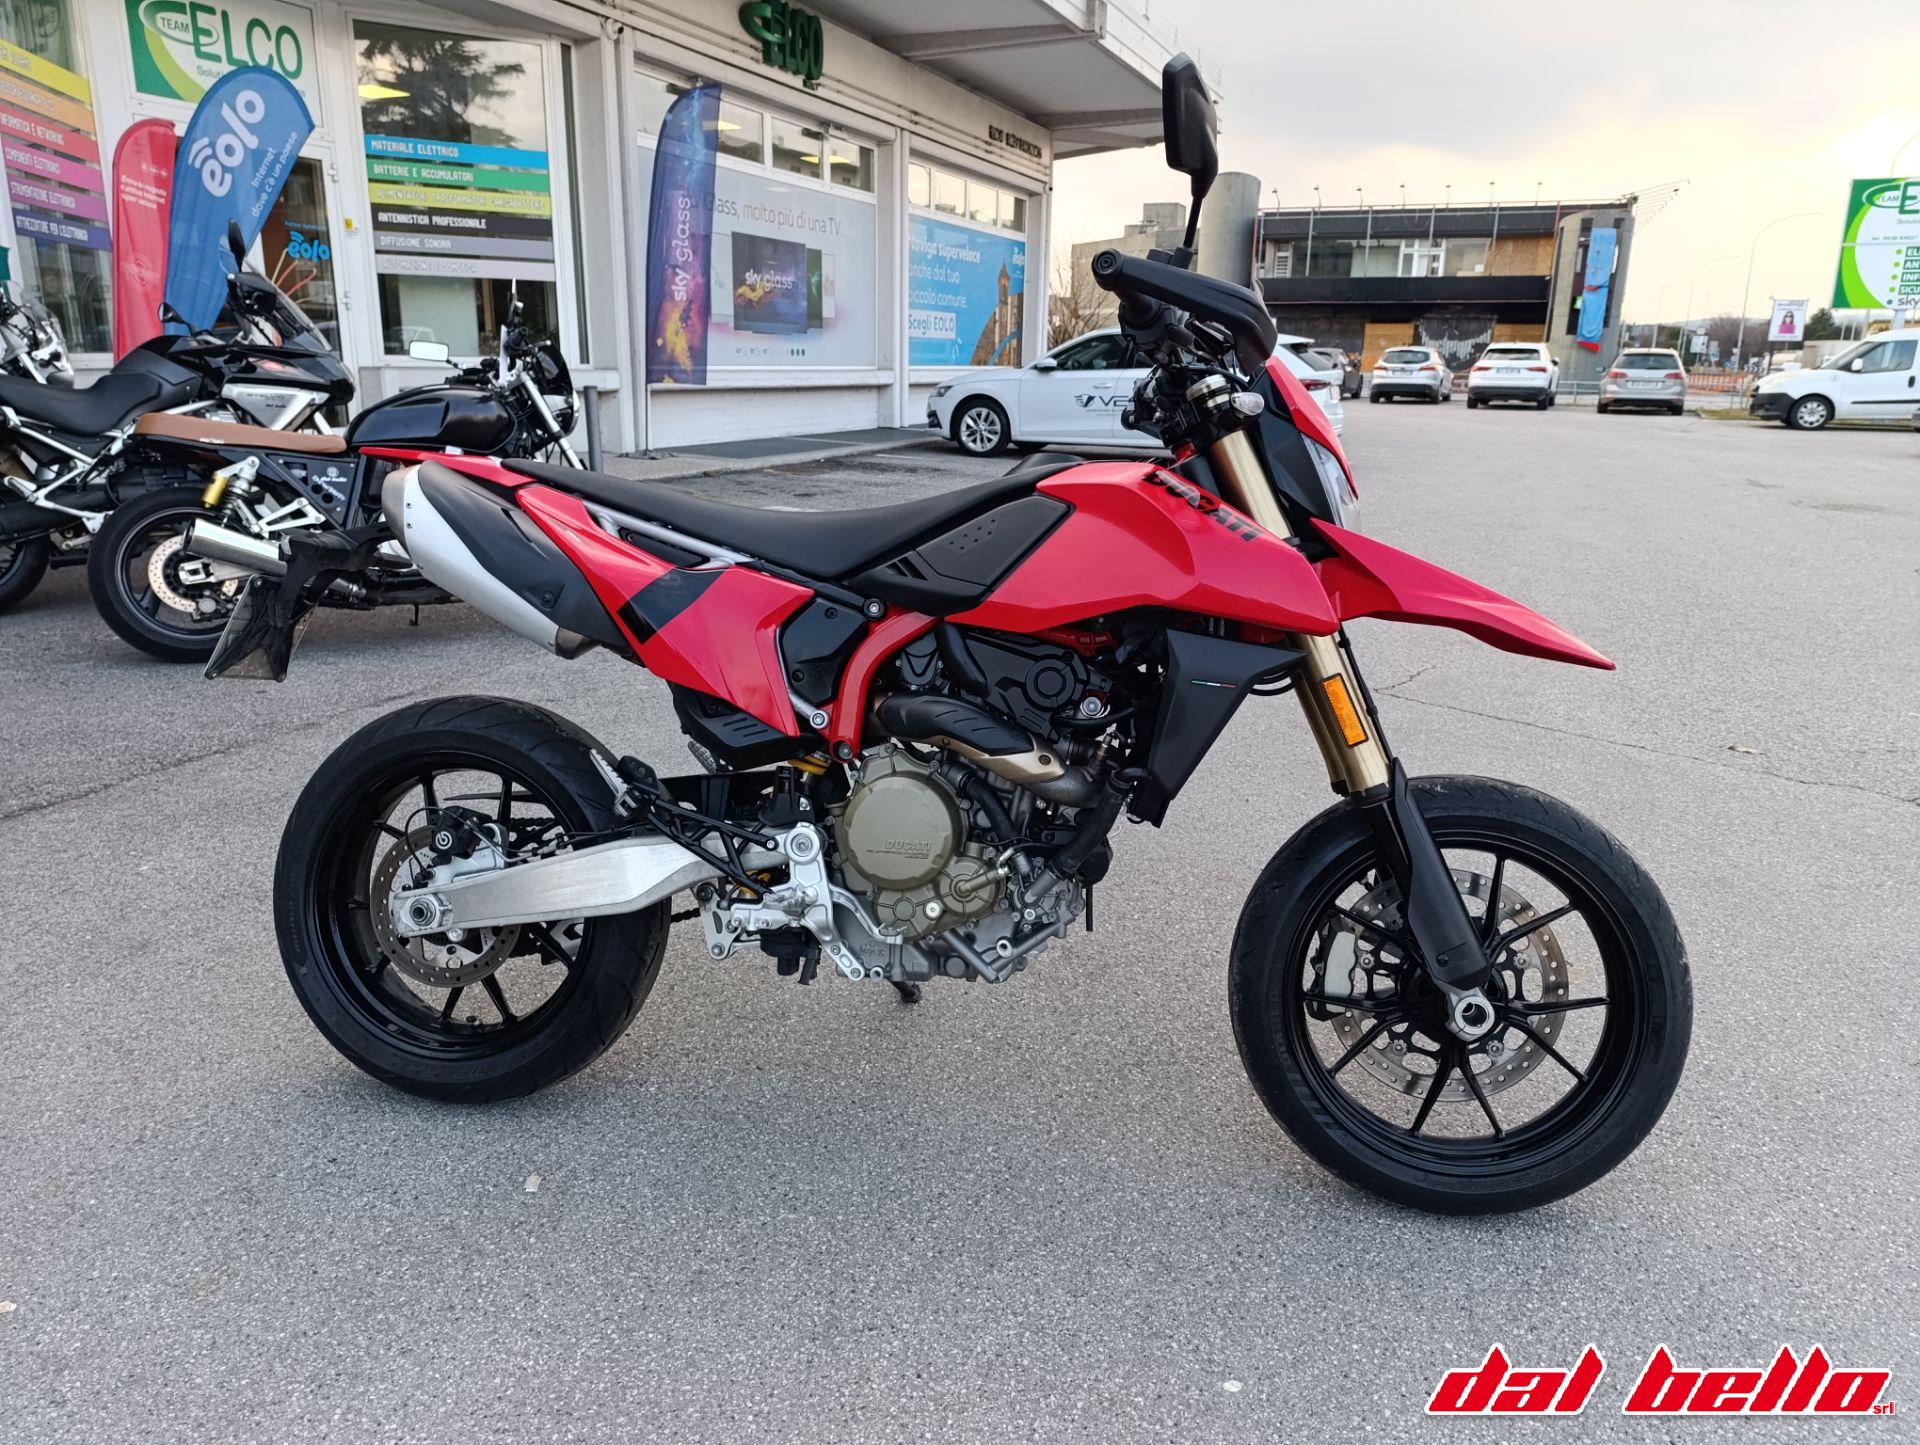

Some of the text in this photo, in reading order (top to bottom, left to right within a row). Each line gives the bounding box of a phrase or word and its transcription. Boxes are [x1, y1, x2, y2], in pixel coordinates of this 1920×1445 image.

[160, 16, 190, 34] TEAM
[189, 1, 302, 79] ELCO
[371, 139, 459, 158] MATERIALE ELETTRICO
[251, 147, 276, 188] Internet
[374, 164, 474, 182] BATTERIE E ACCUMULATORI
[250, 192, 269, 217] dove
[272, 162, 283, 178] un
[378, 211, 487, 229] ANTENNISTICA PROFESSIONALE
[743, 202, 777, 224] molto
[778, 208, 795, 231] più
[797, 210, 807, 230] di
[808, 218, 827, 234] una
[380, 235, 452, 249] DIFFUSIONE SONORA
[671, 196, 693, 301] sky glass
[938, 244, 981, 264] superveloce
[745, 268, 794, 291] sky glass
[933, 263, 946, 282] dal
[947, 267, 960, 283] tuo
[908, 313, 955, 336] Scegli EOLO
[885, 839, 932, 852] DUCATI
